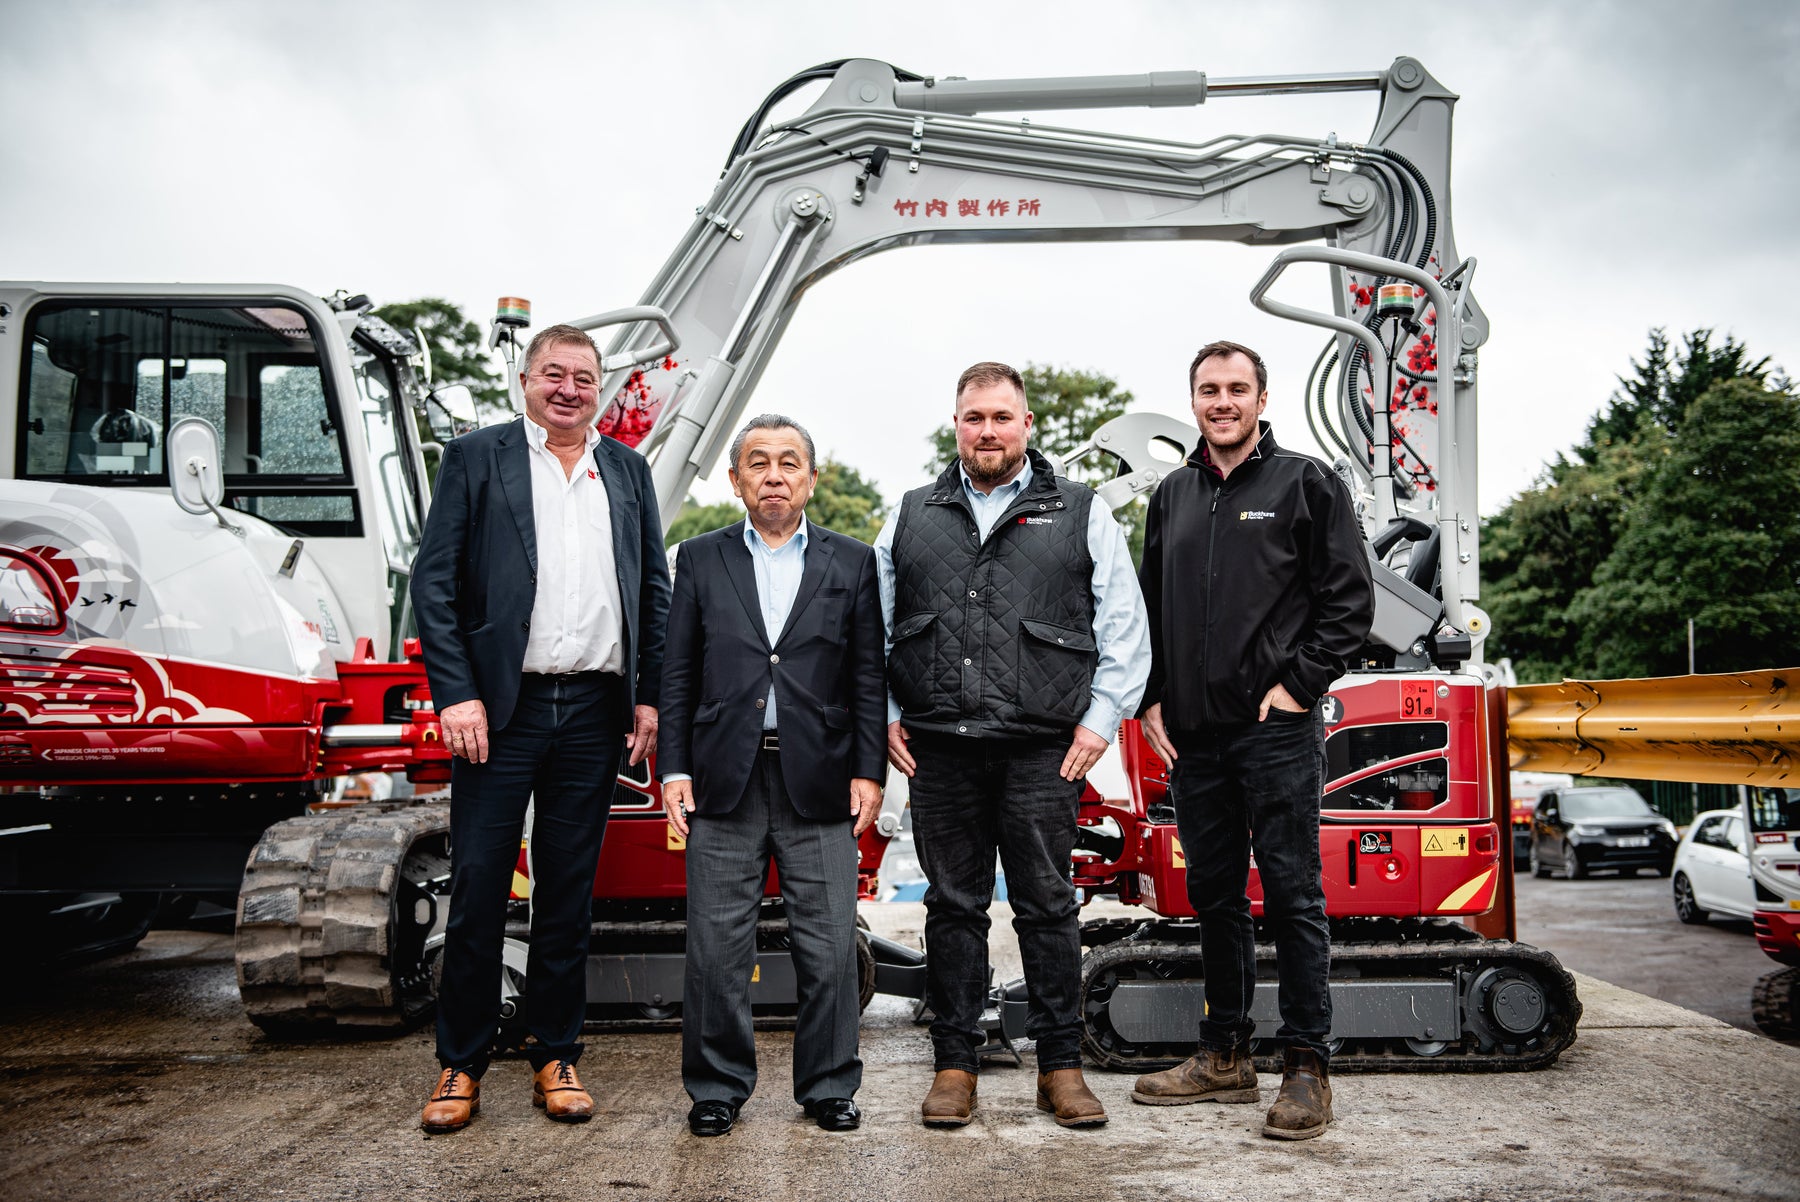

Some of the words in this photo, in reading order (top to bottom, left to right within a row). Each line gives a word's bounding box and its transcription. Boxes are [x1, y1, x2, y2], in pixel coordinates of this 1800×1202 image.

[893, 198, 1041, 217] 竹内製作所
[1405, 696, 1421, 715] 91
[1423, 707, 1433, 715] dB
